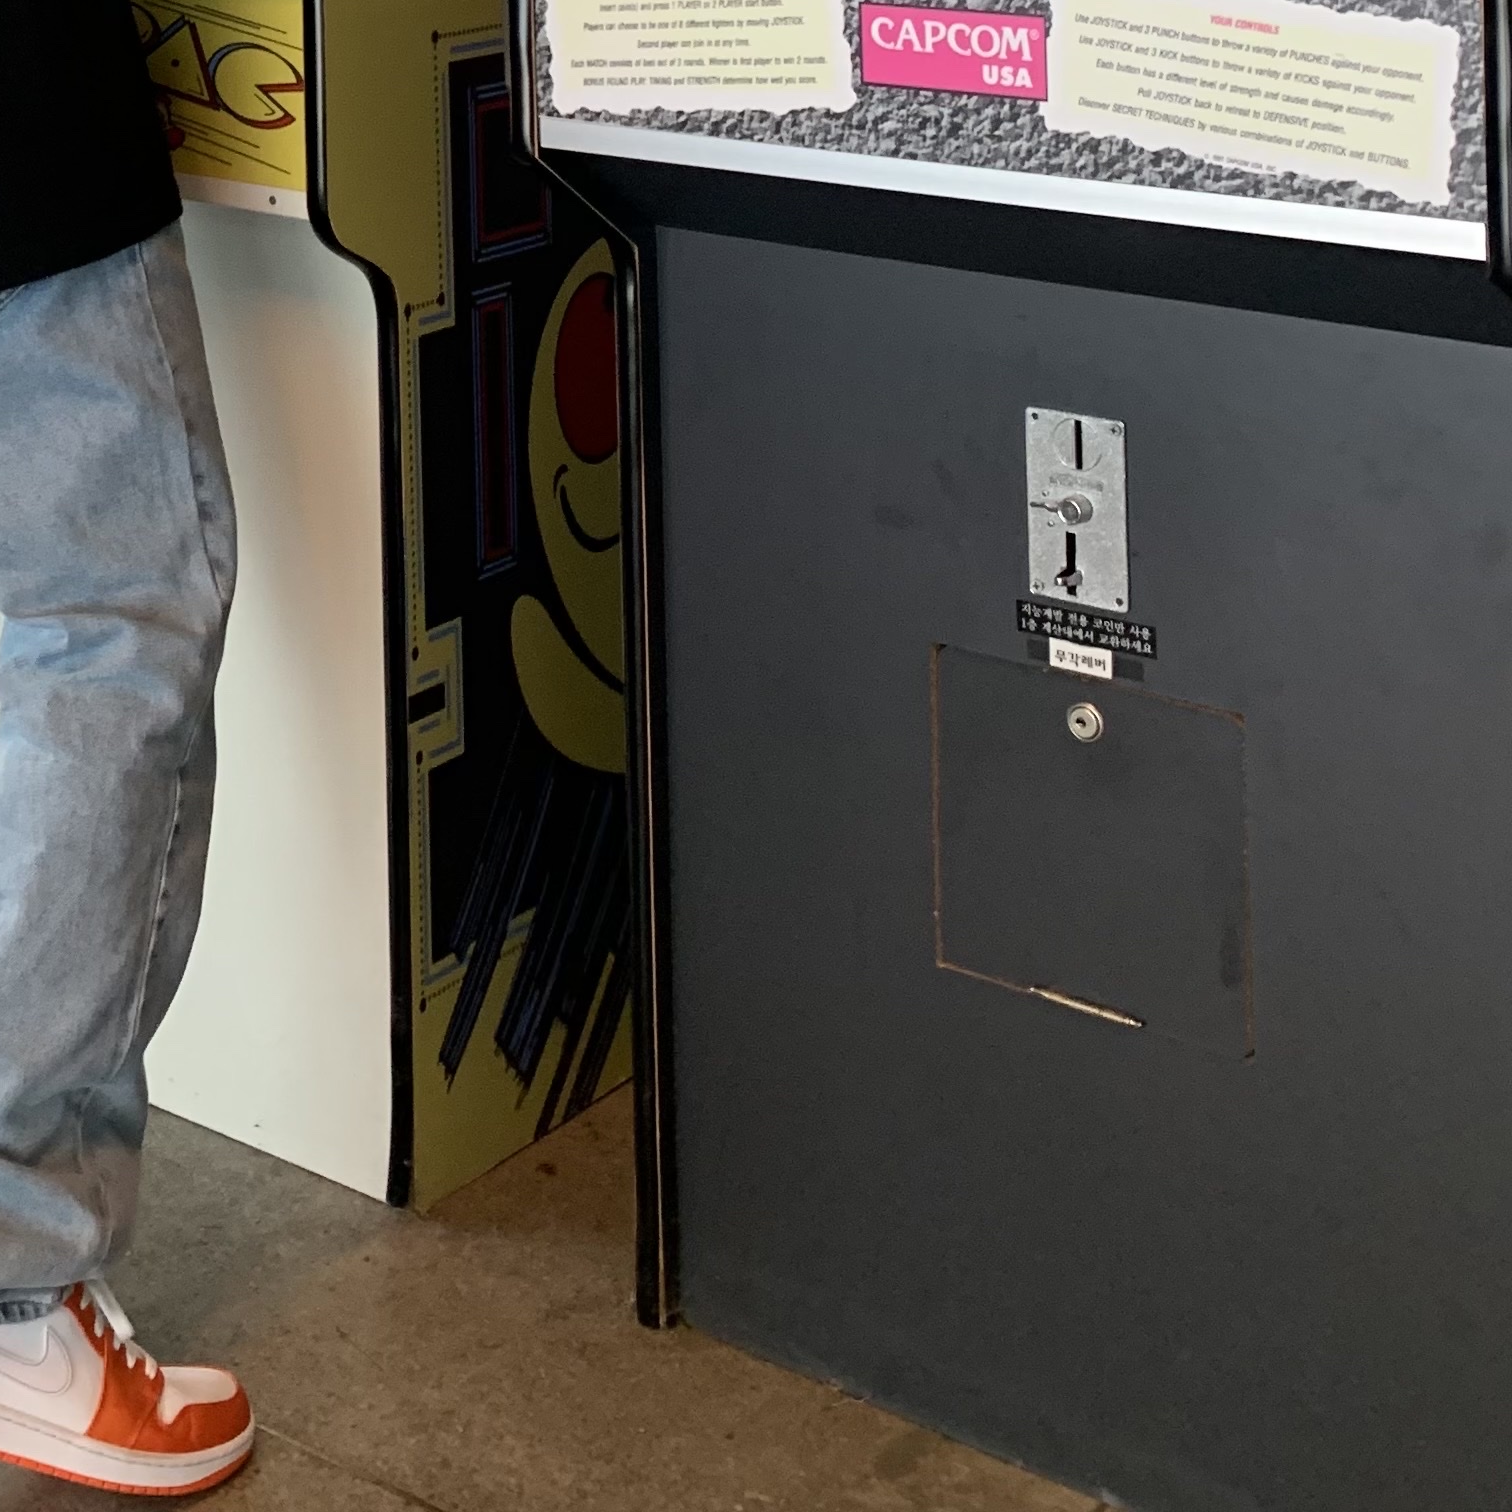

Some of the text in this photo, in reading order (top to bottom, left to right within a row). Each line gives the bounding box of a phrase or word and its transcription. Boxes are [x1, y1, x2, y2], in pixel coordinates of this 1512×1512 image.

[870, 16, 1033, 62] CAPCOM
[1074, 13, 1089, 24] Use
[1089, 16, 1128, 29] JOYSTICK
[1128, 24, 1143, 33] and
[1144, 24, 1150, 34] 3
[1151, 25, 1180, 39] PUNCH
[1180, 31, 1210, 44] buttons
[1211, 37, 1220, 46] to
[1221, 39, 1244, 50] throw
[1251, 45, 1278, 58] variety
[1278, 49, 1288, 57] of
[1288, 49, 1330, 65] PUNCHES
[1330, 59, 1361, 71] against
[1360, 64, 1380, 73] your
[1210, 15, 1280, 34] YOUR CONTROLS
[982, 64, 1033, 88] USA
[1078, 34, 1093, 45] Use
[1094, 37, 1132, 52] JOYSTICK
[1134, 46, 1149, 55] and
[1150, 47, 1157, 56] 3
[1158, 49, 1178, 59] KICK
[1179, 52, 1209, 66] buttons
[1211, 58, 1220, 68] to
[1222, 60, 1245, 71] throw
[1247, 66, 1252, 74] a
[1254, 67, 1281, 80] variety
[1282, 71, 1292, 80] of
[1293, 72, 1320, 85] KICKS
[1322, 79, 1352, 91] against
[1352, 85, 1372, 94] your
[1077, 96, 1110, 110] Discover
[1111, 102, 1143, 116] SECRET
[1145, 109, 1195, 128] TECHNIQUES
[1197, 120, 1206, 131] by
[1209, 124, 1237, 136] various
[1239, 130, 1292, 146] combinations
[1294, 138, 1304, 148] of
[1305, 140, 1346, 156] JOYSTICK
[1348, 150, 1364, 160] and
[1136, 87, 1152, 97] Pull
[1152, 90, 1192, 105] JOYSTICK
[1193, 97, 1212, 109] back
[1214, 102, 1222, 112] to
[1224, 105, 1250, 116] retreat
[1252, 109, 1260, 119] to
[1262, 110, 1309, 127] DEFENSIVE
[1130, 626, 1152, 640] 사용
